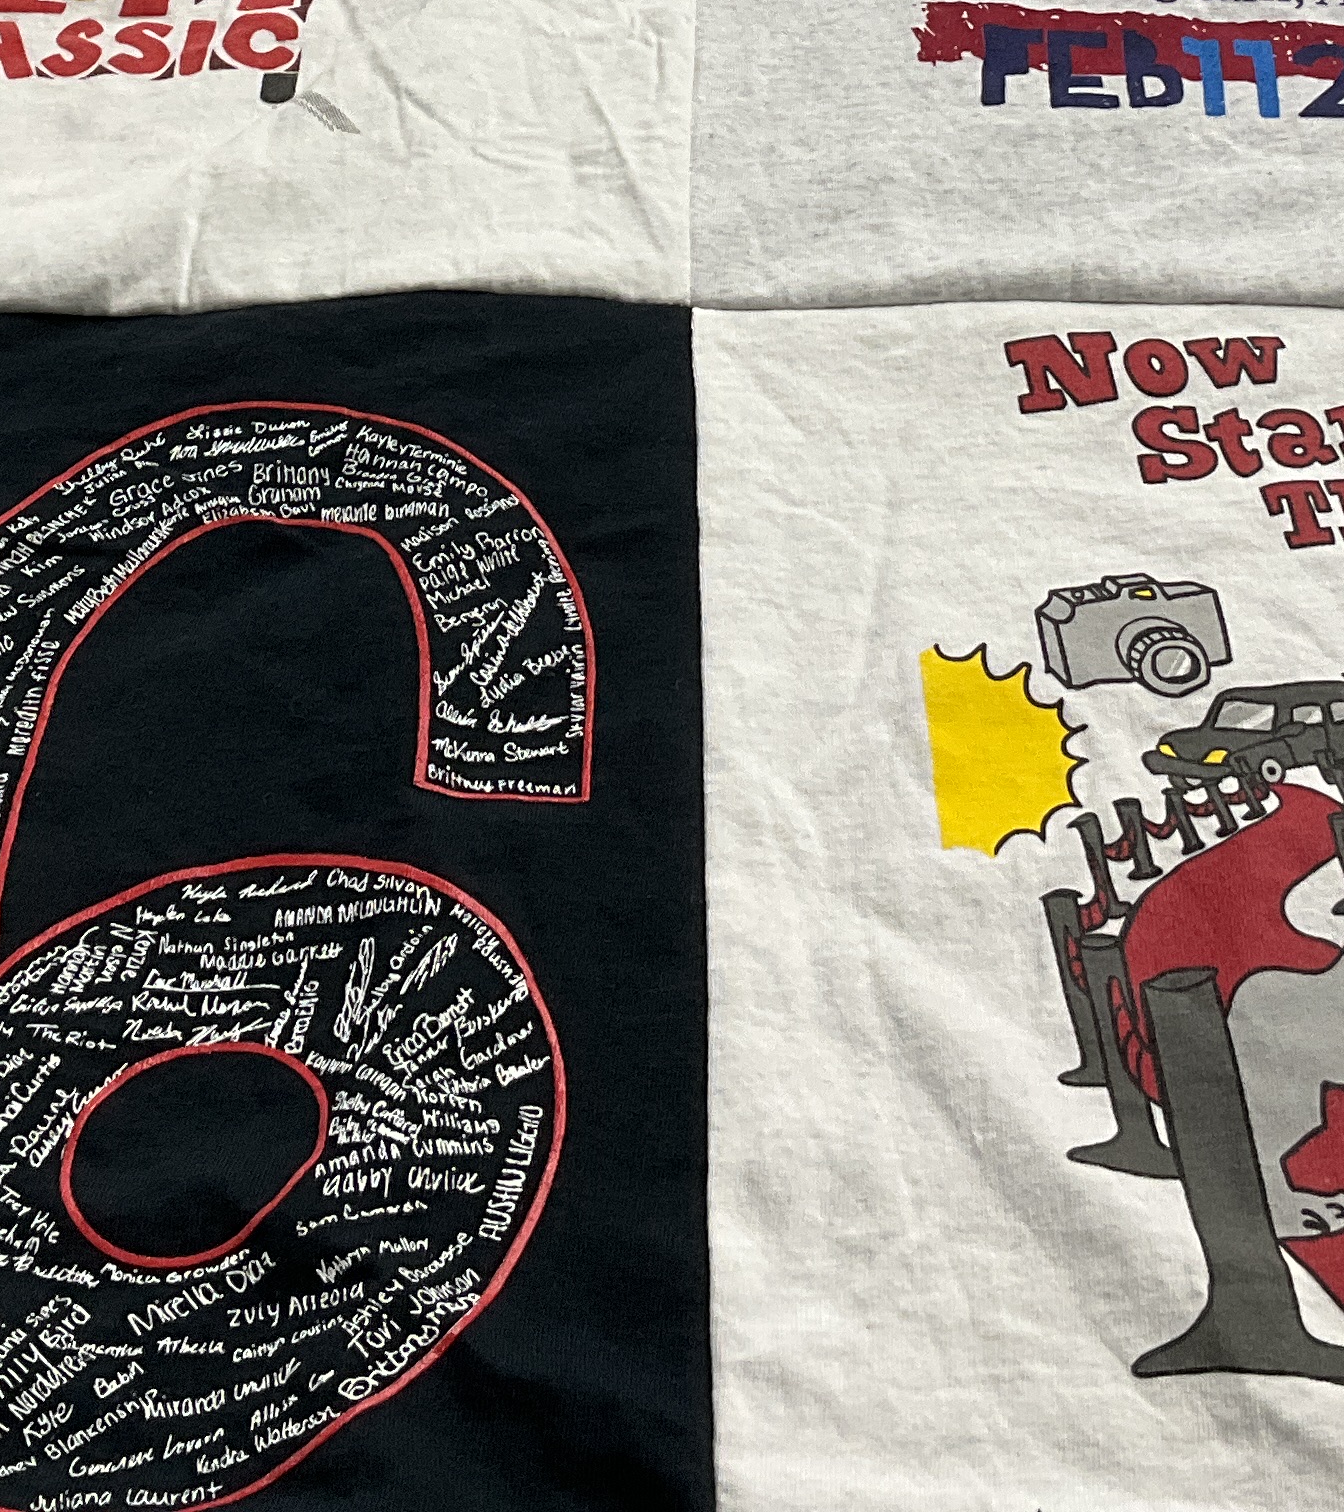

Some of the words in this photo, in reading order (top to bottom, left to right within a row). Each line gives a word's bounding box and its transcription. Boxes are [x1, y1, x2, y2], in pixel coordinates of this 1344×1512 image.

[1179, 36, 1281, 120] 11
[109, 473, 175, 508] Grace
[65, 1029, 117, 1052] Riot
